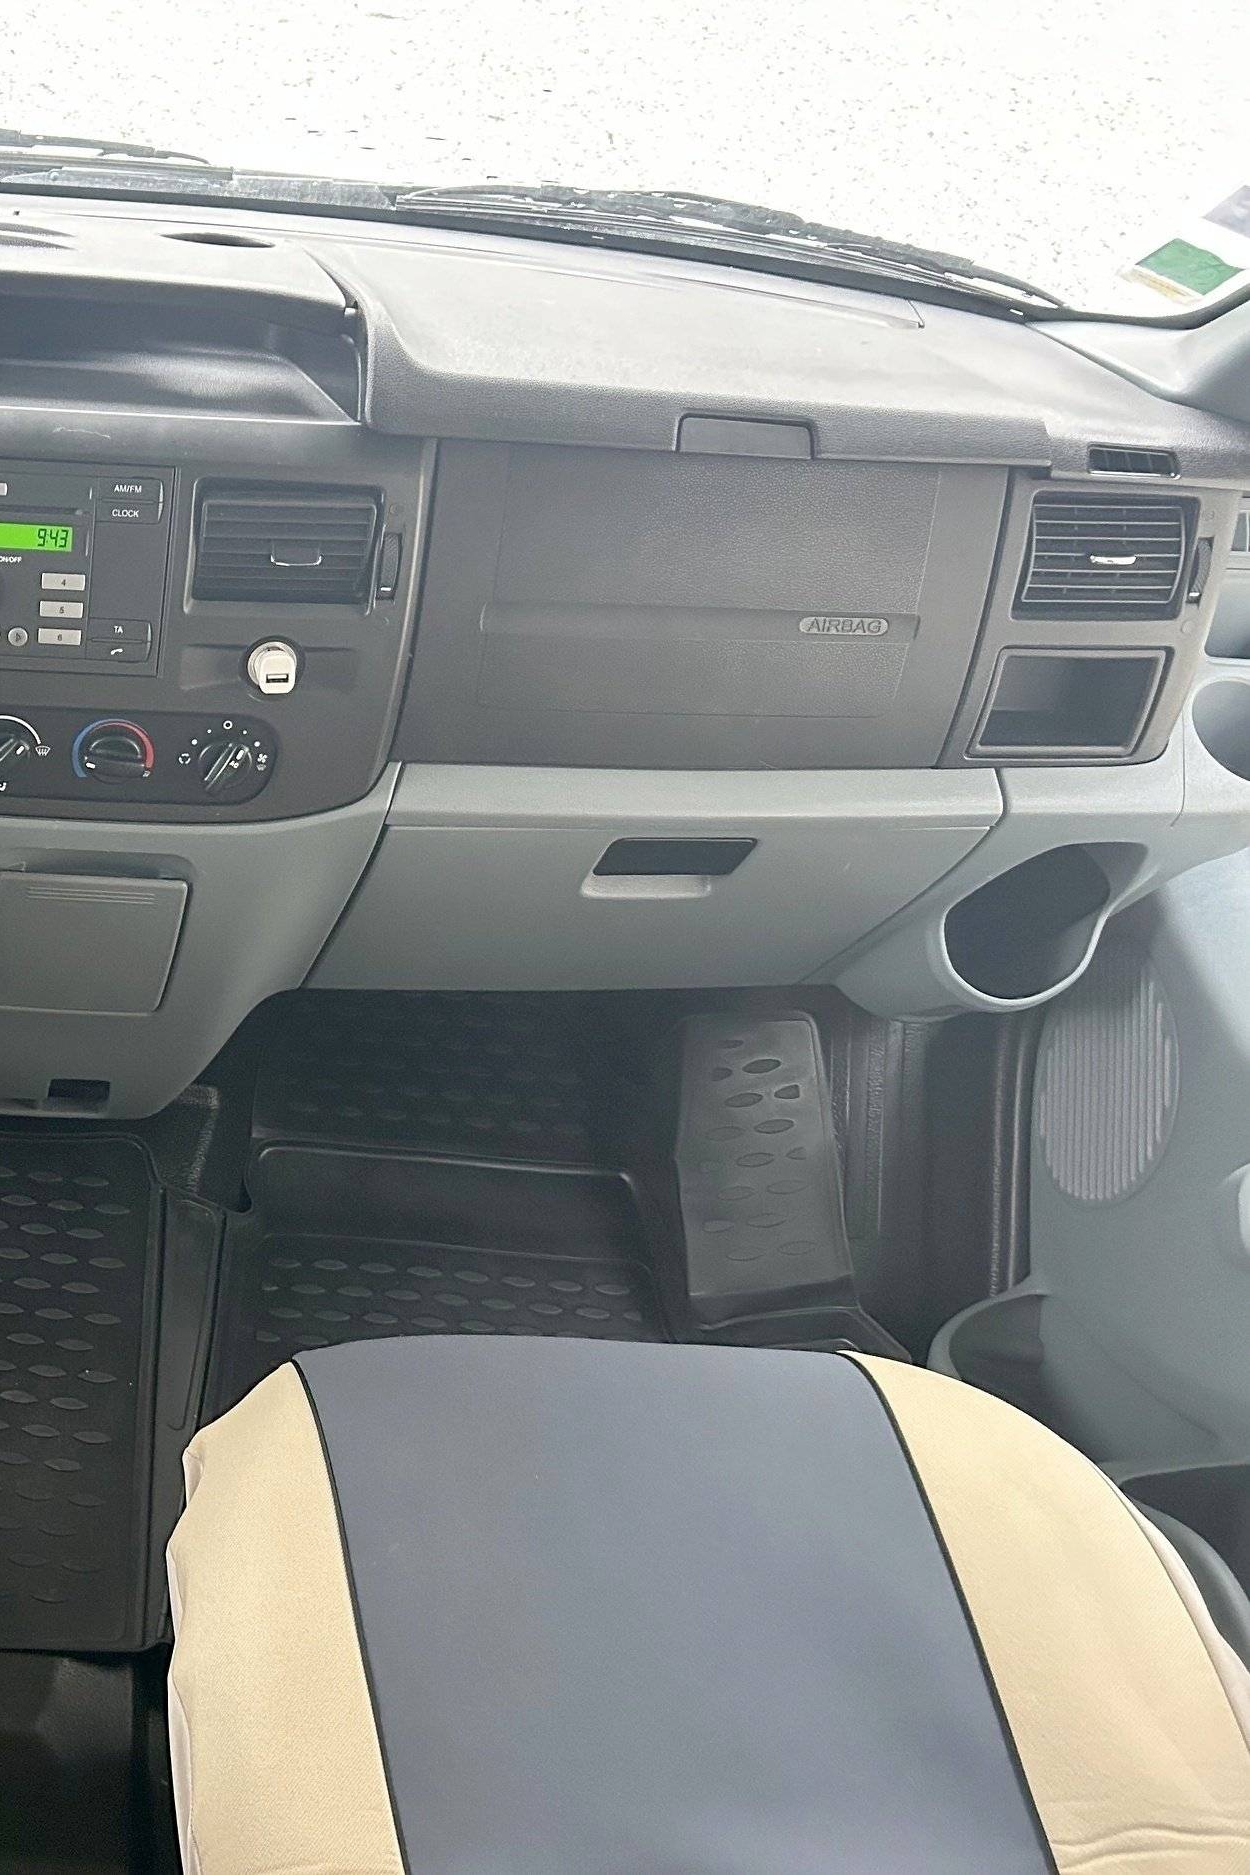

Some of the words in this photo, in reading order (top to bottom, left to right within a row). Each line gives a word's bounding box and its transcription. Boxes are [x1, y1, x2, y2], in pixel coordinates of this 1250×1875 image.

[113, 485, 143, 494] AM/FM
[111, 508, 140, 518] CLOCK
[113, 625, 124, 634] TA
[807, 618, 882, 634] AIRBAG
